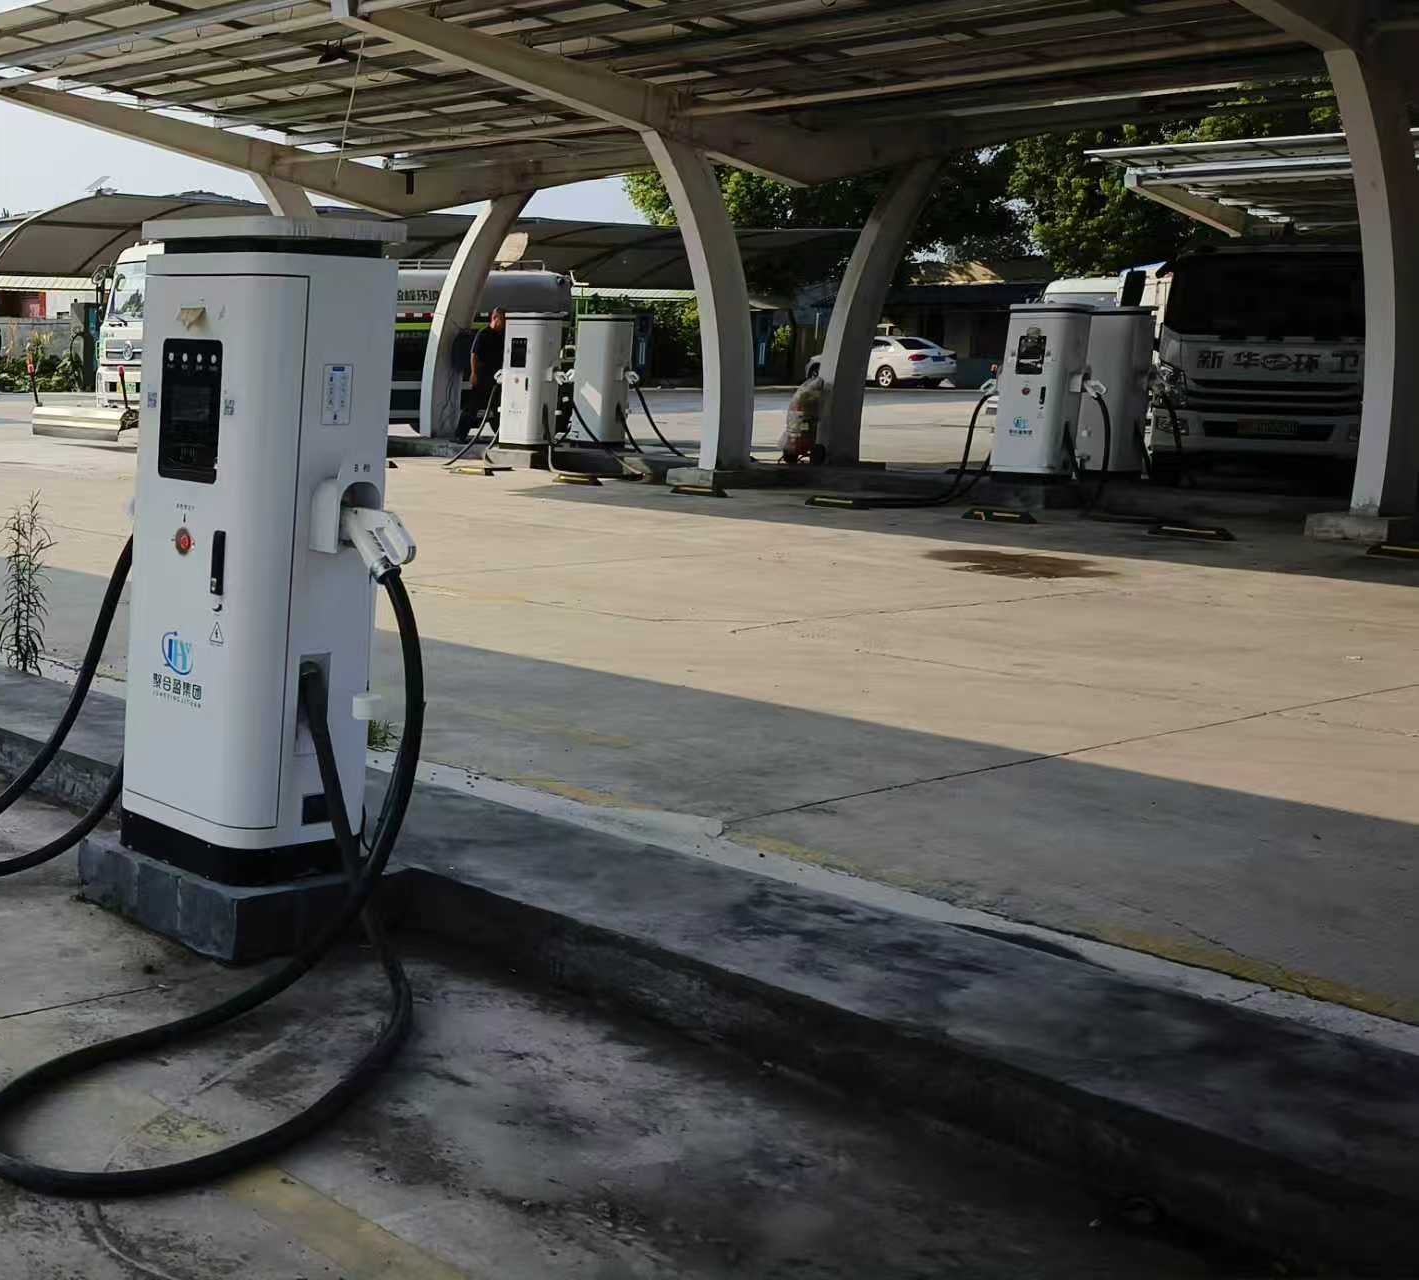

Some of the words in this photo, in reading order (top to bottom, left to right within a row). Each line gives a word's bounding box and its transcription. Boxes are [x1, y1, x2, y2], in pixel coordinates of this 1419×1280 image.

[152, 672, 203, 701] 聚合盈集团
